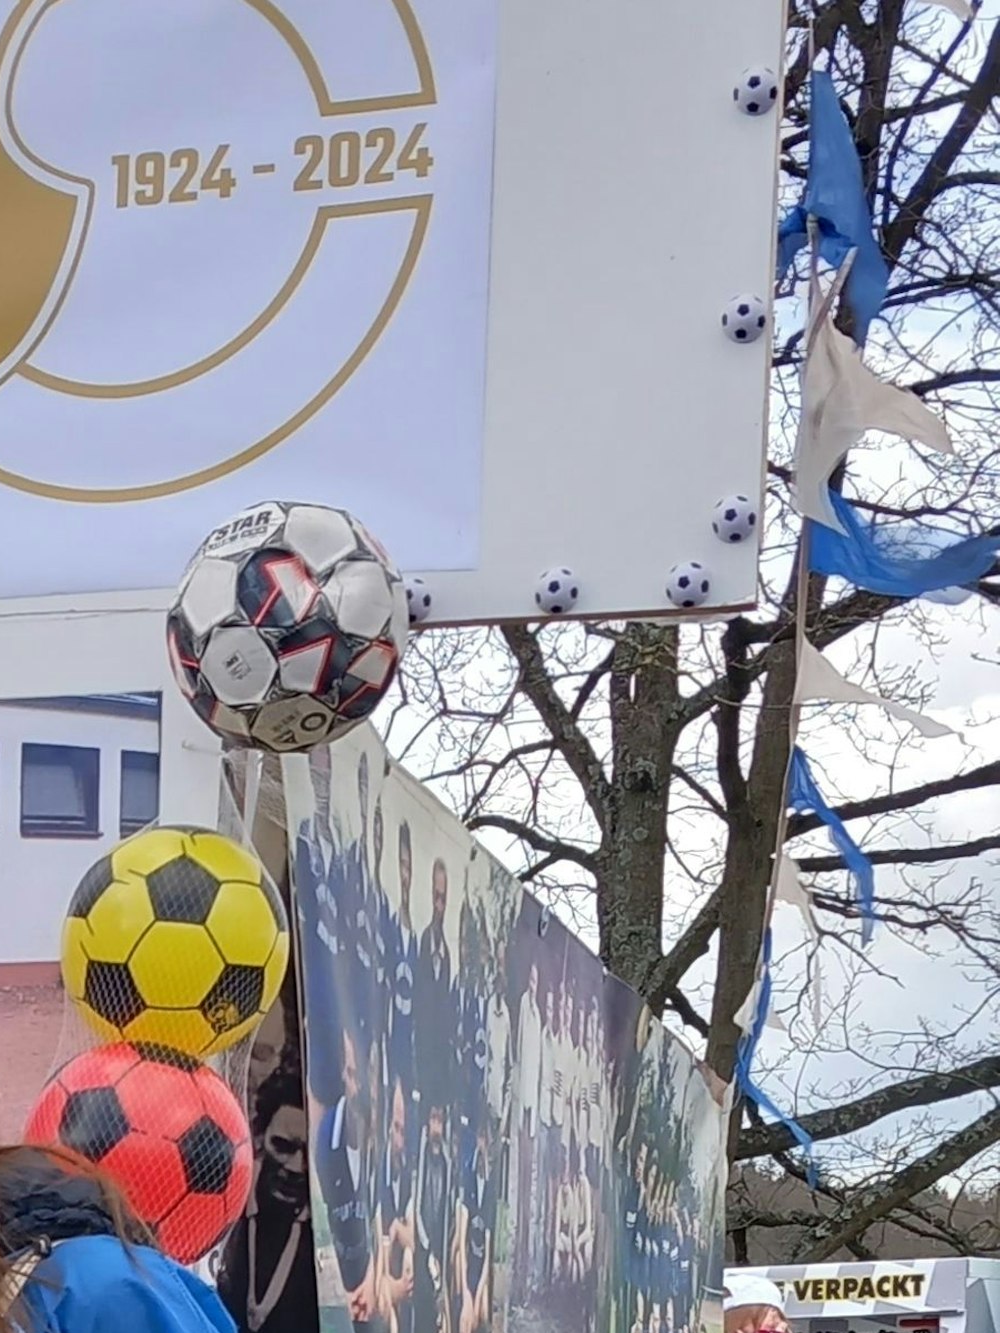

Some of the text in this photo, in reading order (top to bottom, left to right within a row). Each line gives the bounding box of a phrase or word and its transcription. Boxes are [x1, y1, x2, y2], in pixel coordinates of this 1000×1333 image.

[111, 143, 237, 208] 1924
[292, 122, 434, 191] 2024
[793, 1274, 926, 1301] VERPACKT
